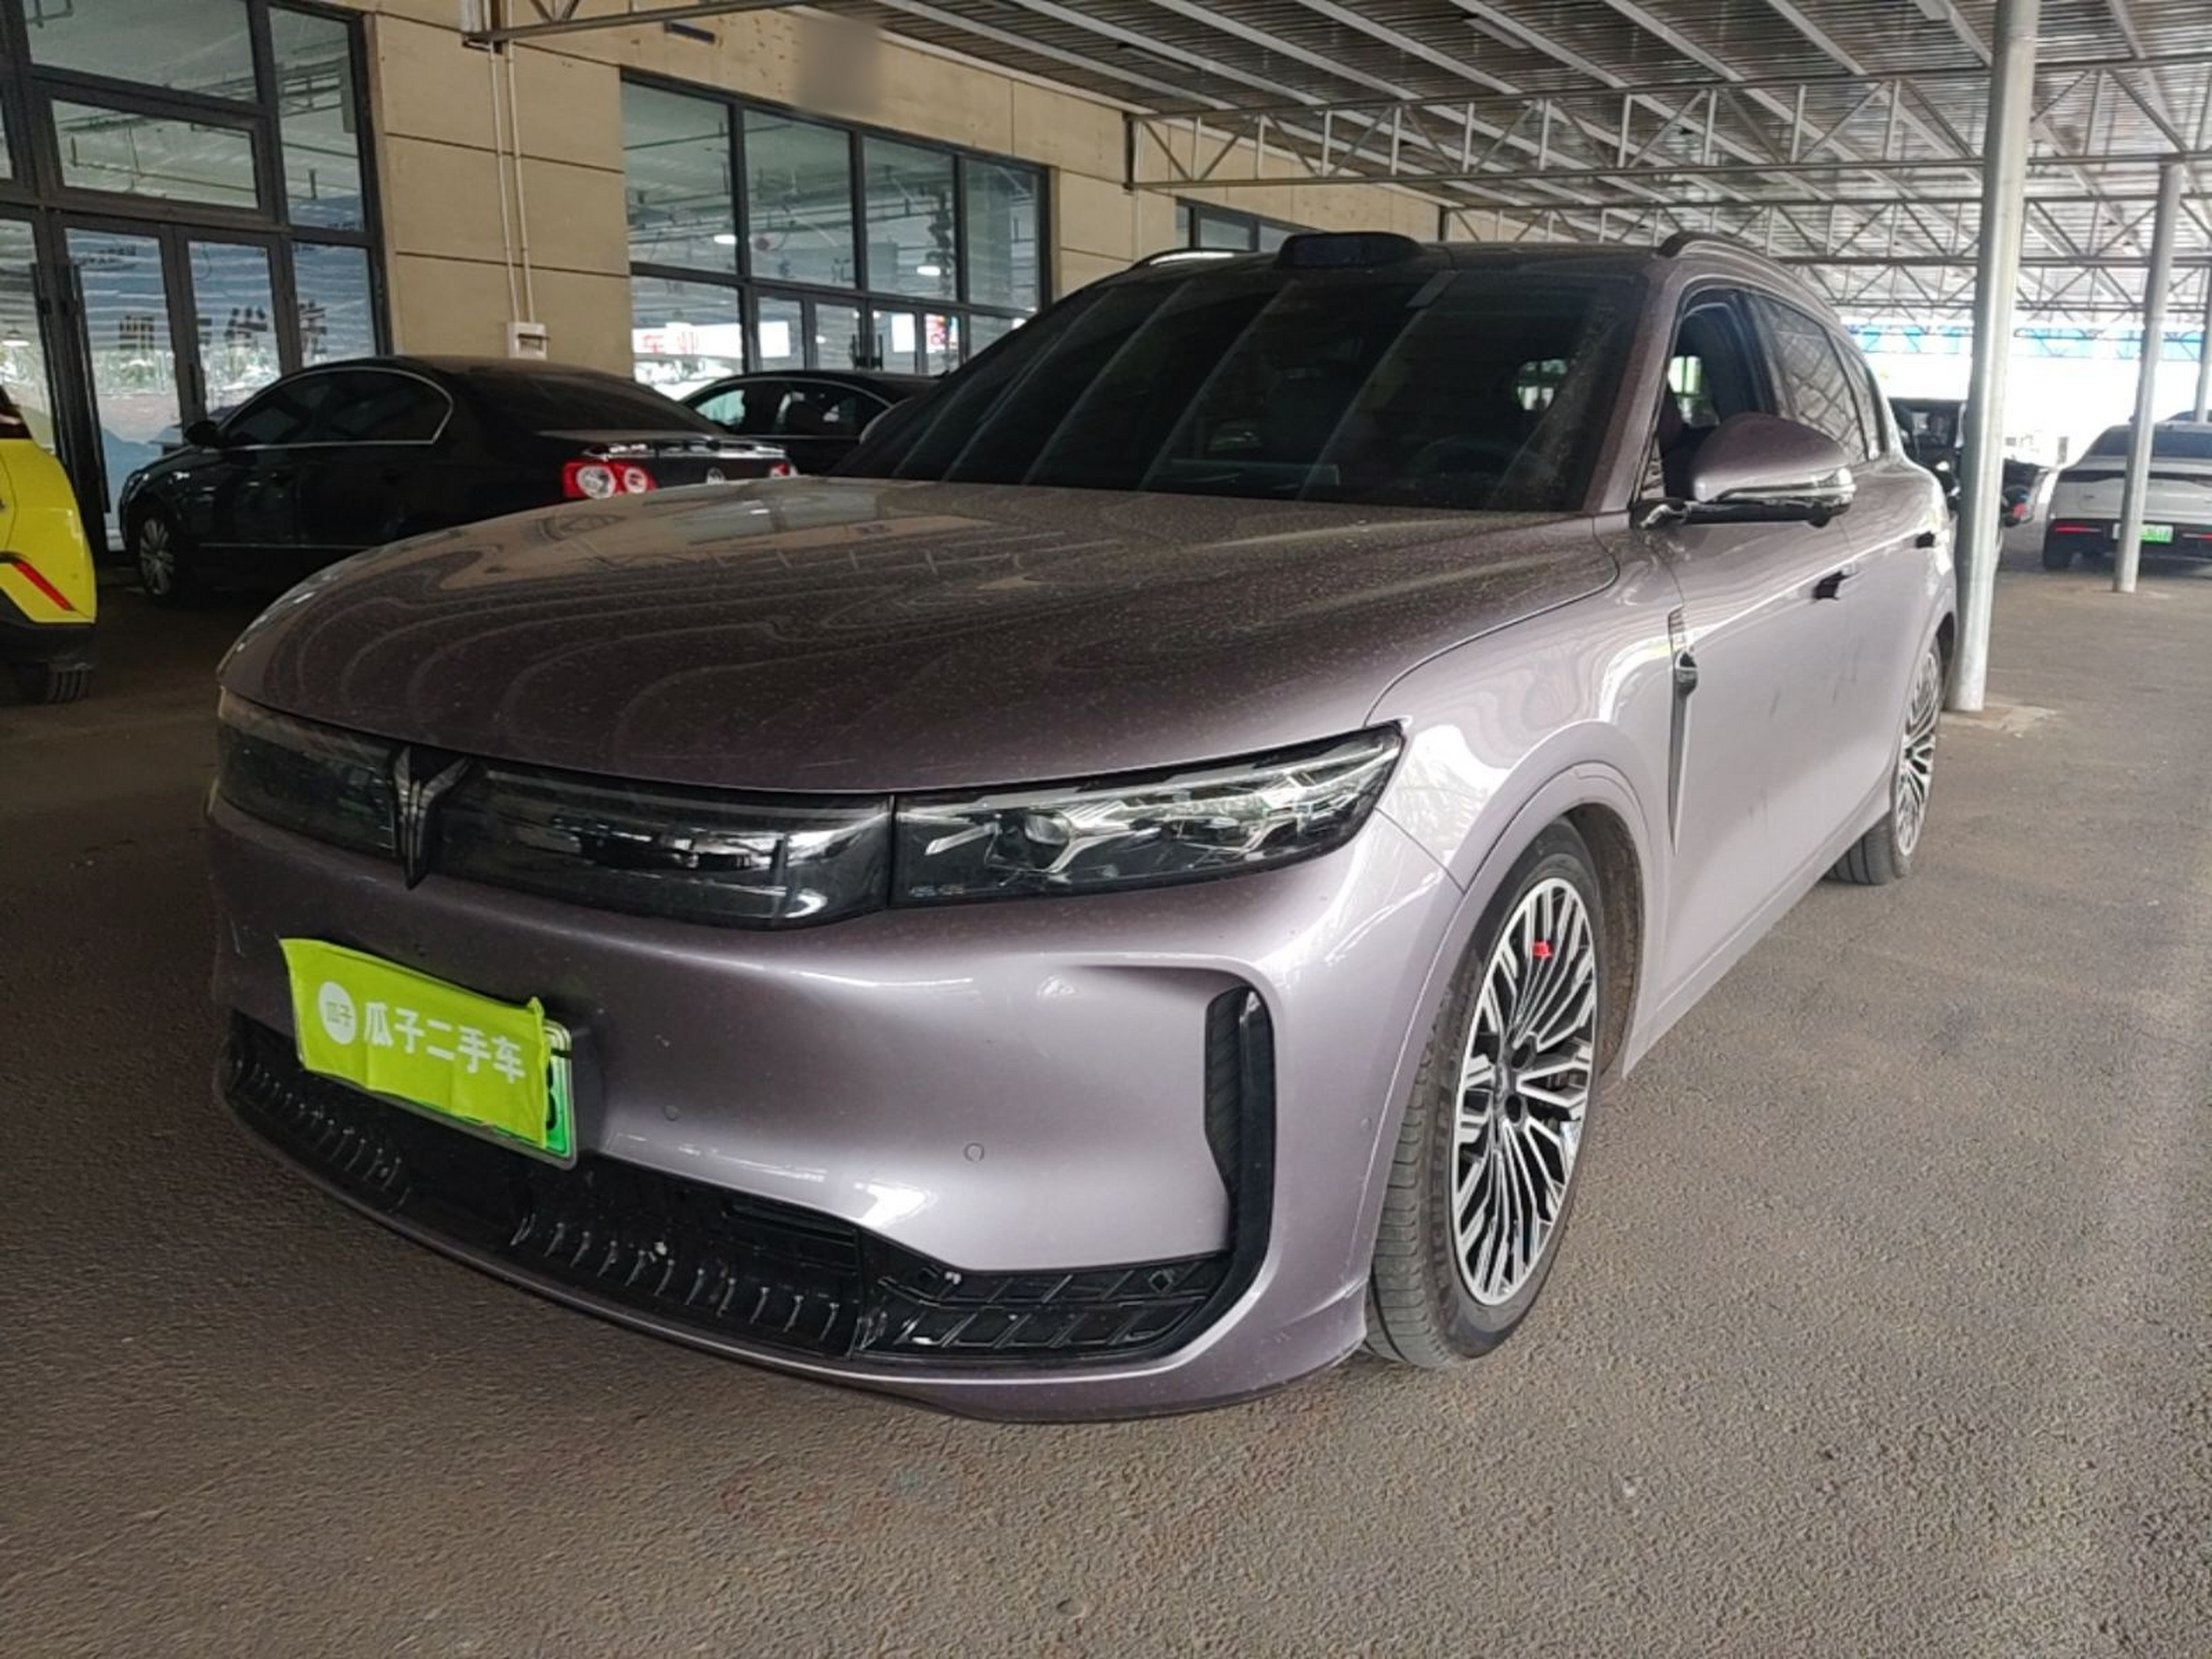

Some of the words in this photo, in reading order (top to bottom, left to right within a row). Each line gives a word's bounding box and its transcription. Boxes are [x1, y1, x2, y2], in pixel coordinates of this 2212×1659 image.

[363, 1002, 526, 1084] 瓜子二手车
